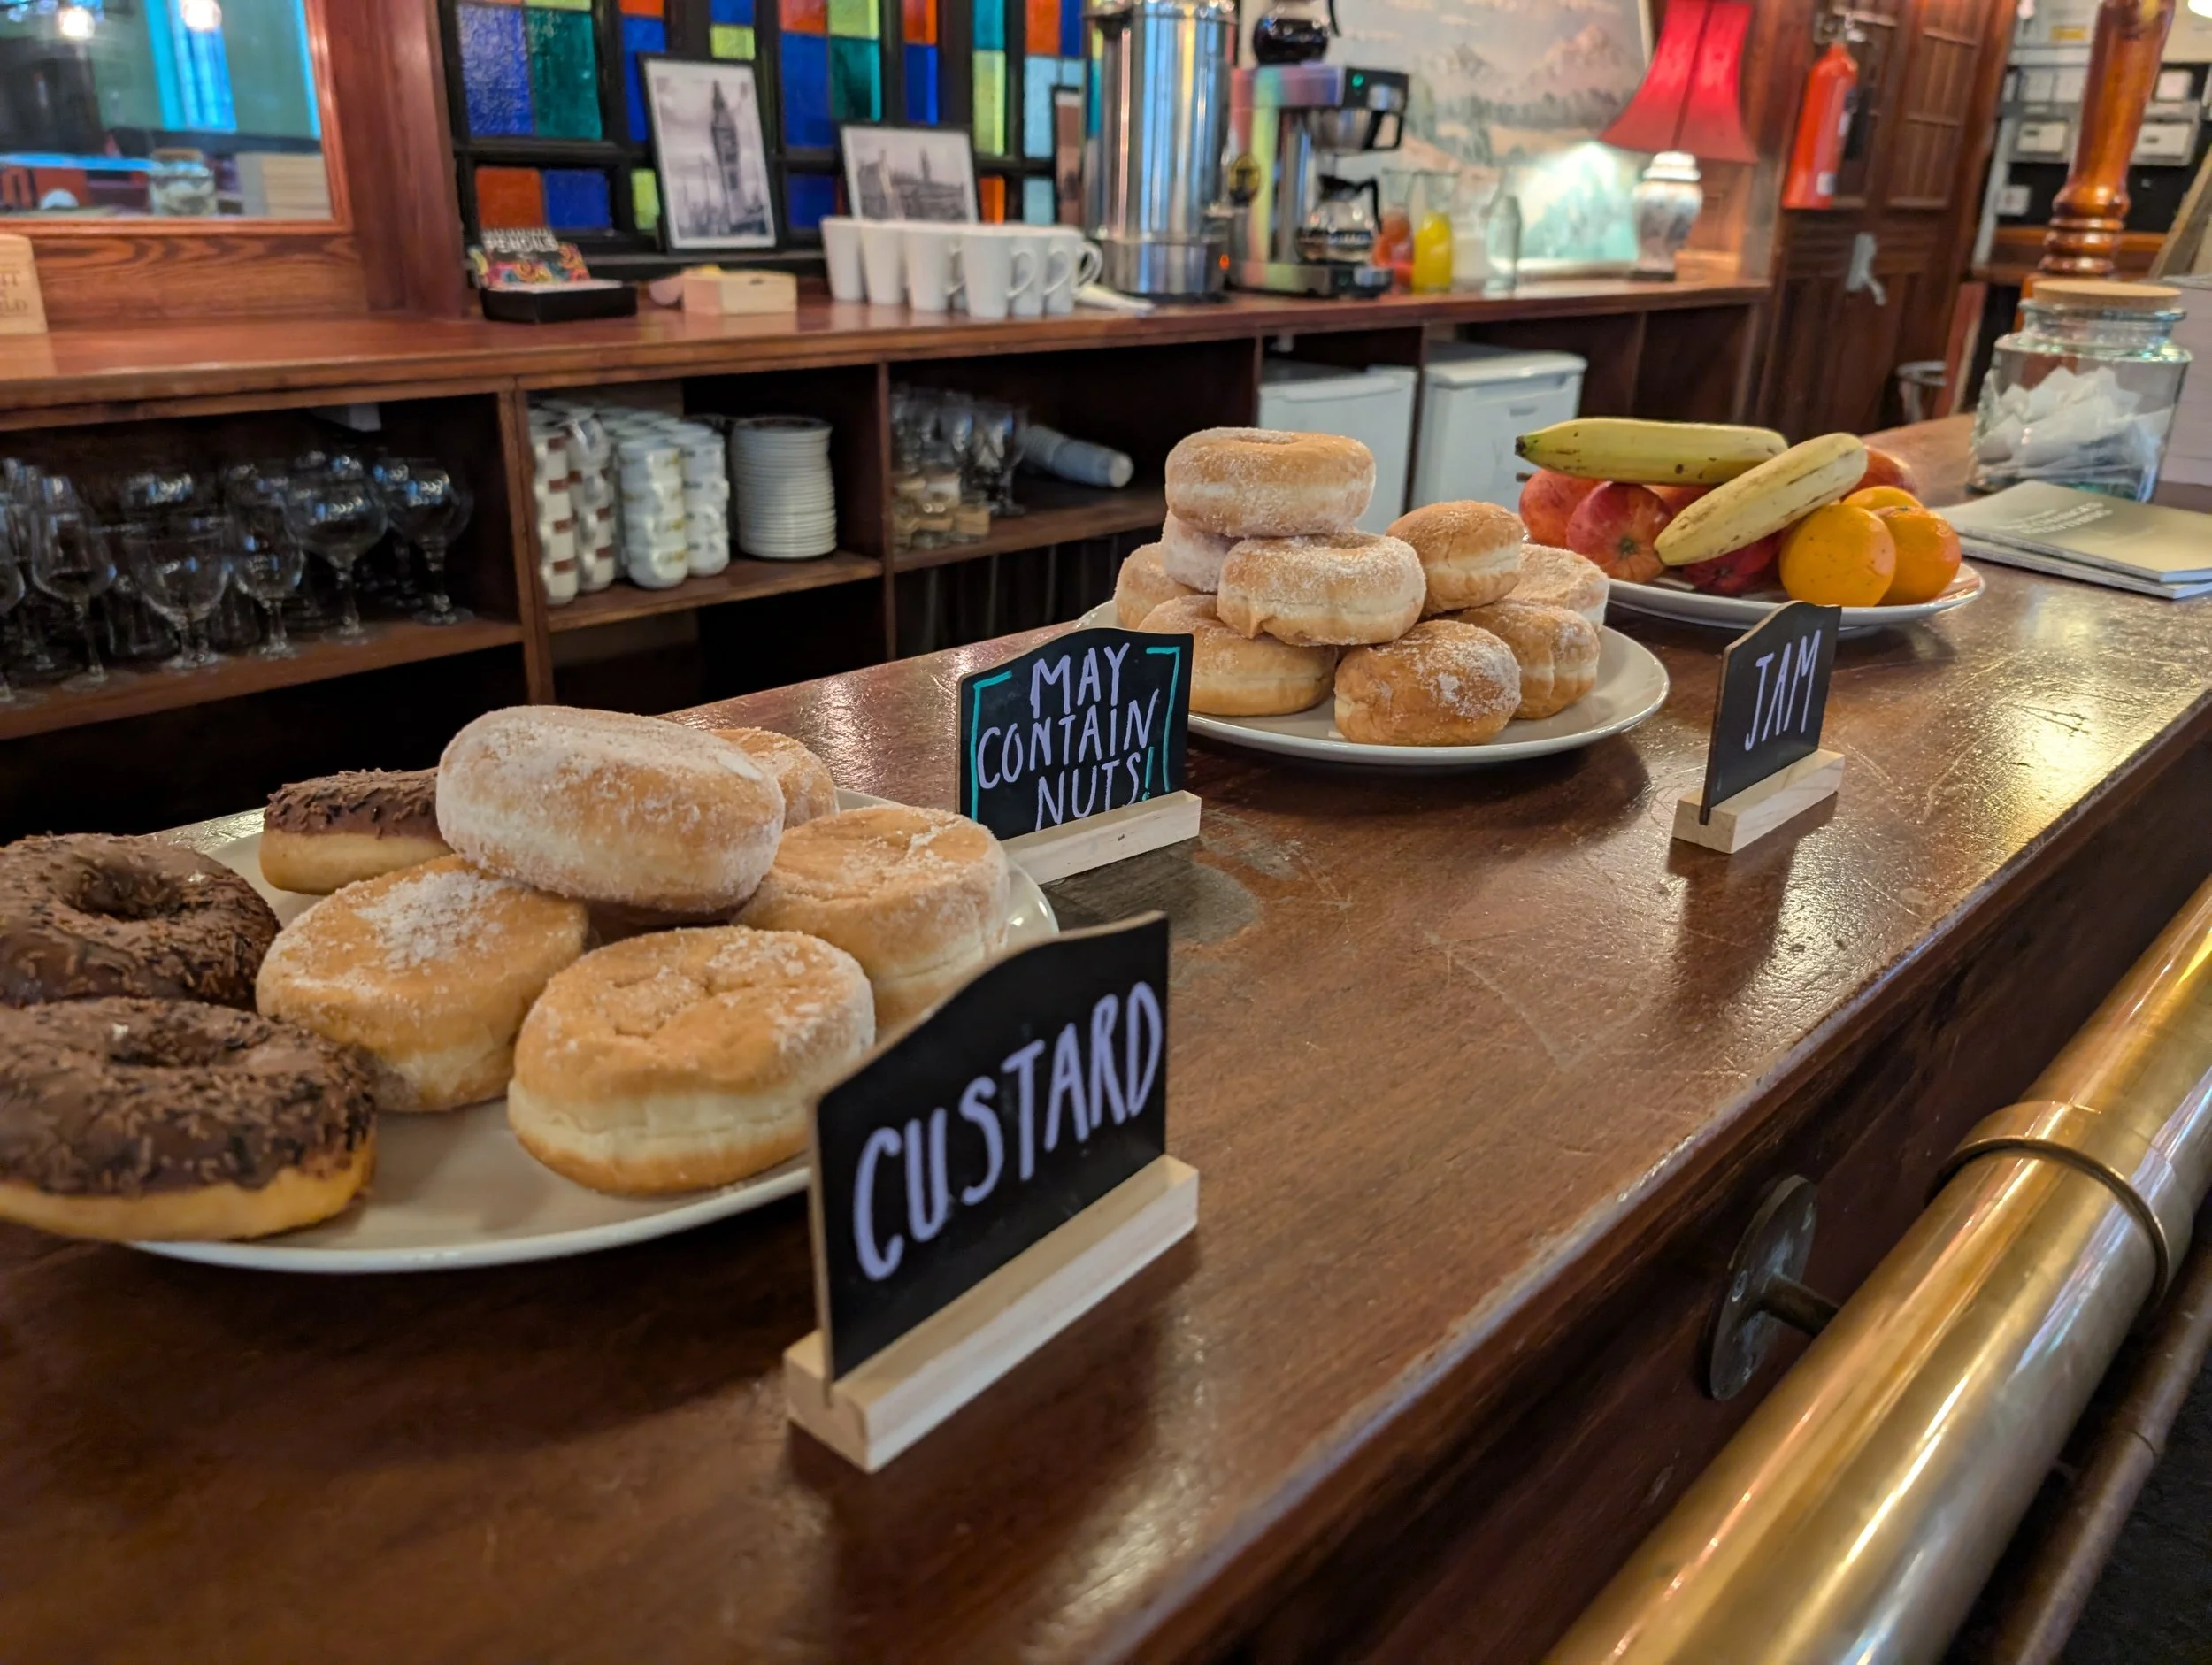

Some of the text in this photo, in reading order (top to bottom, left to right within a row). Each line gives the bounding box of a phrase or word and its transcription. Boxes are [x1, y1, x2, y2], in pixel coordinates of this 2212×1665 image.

[1030, 643, 1130, 718] MAY
[1745, 629, 1821, 751] JAM
[978, 688, 1159, 789] CONTAIN
[854, 982, 1163, 1280] CUSTARD
